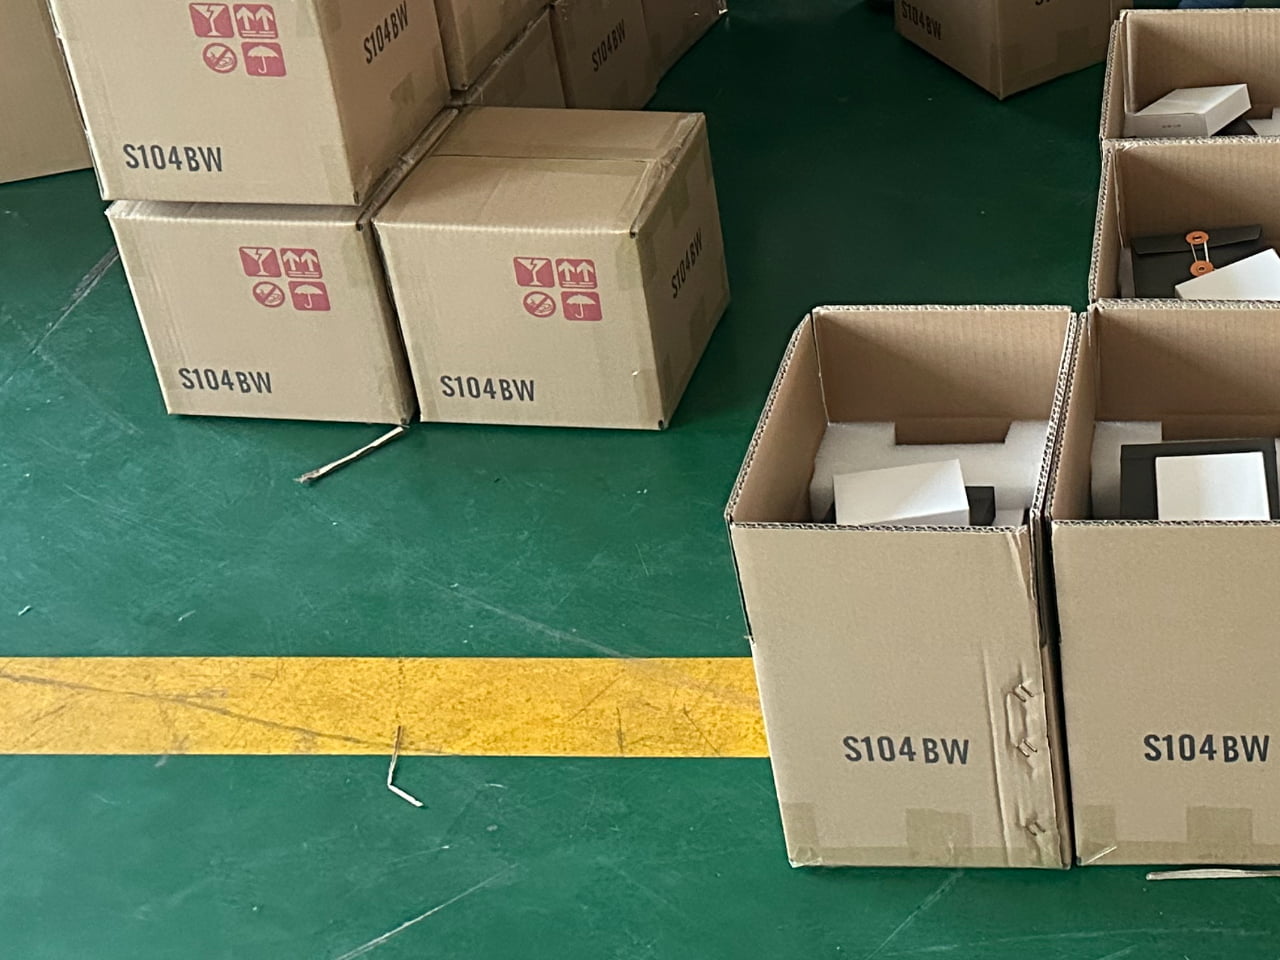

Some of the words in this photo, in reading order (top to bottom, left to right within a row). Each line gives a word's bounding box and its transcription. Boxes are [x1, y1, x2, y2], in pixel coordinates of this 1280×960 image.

[364, 0, 408, 64] S104BW
[592, 19, 625, 72] S104BW
[123, 144, 222, 172] S104BW
[672, 232, 702, 299] S104BW
[179, 368, 272, 393] S104BW
[441, 376, 534, 401] S104BW
[843, 736, 969, 764] S104BW
[1144, 734, 1269, 762] S104BW
